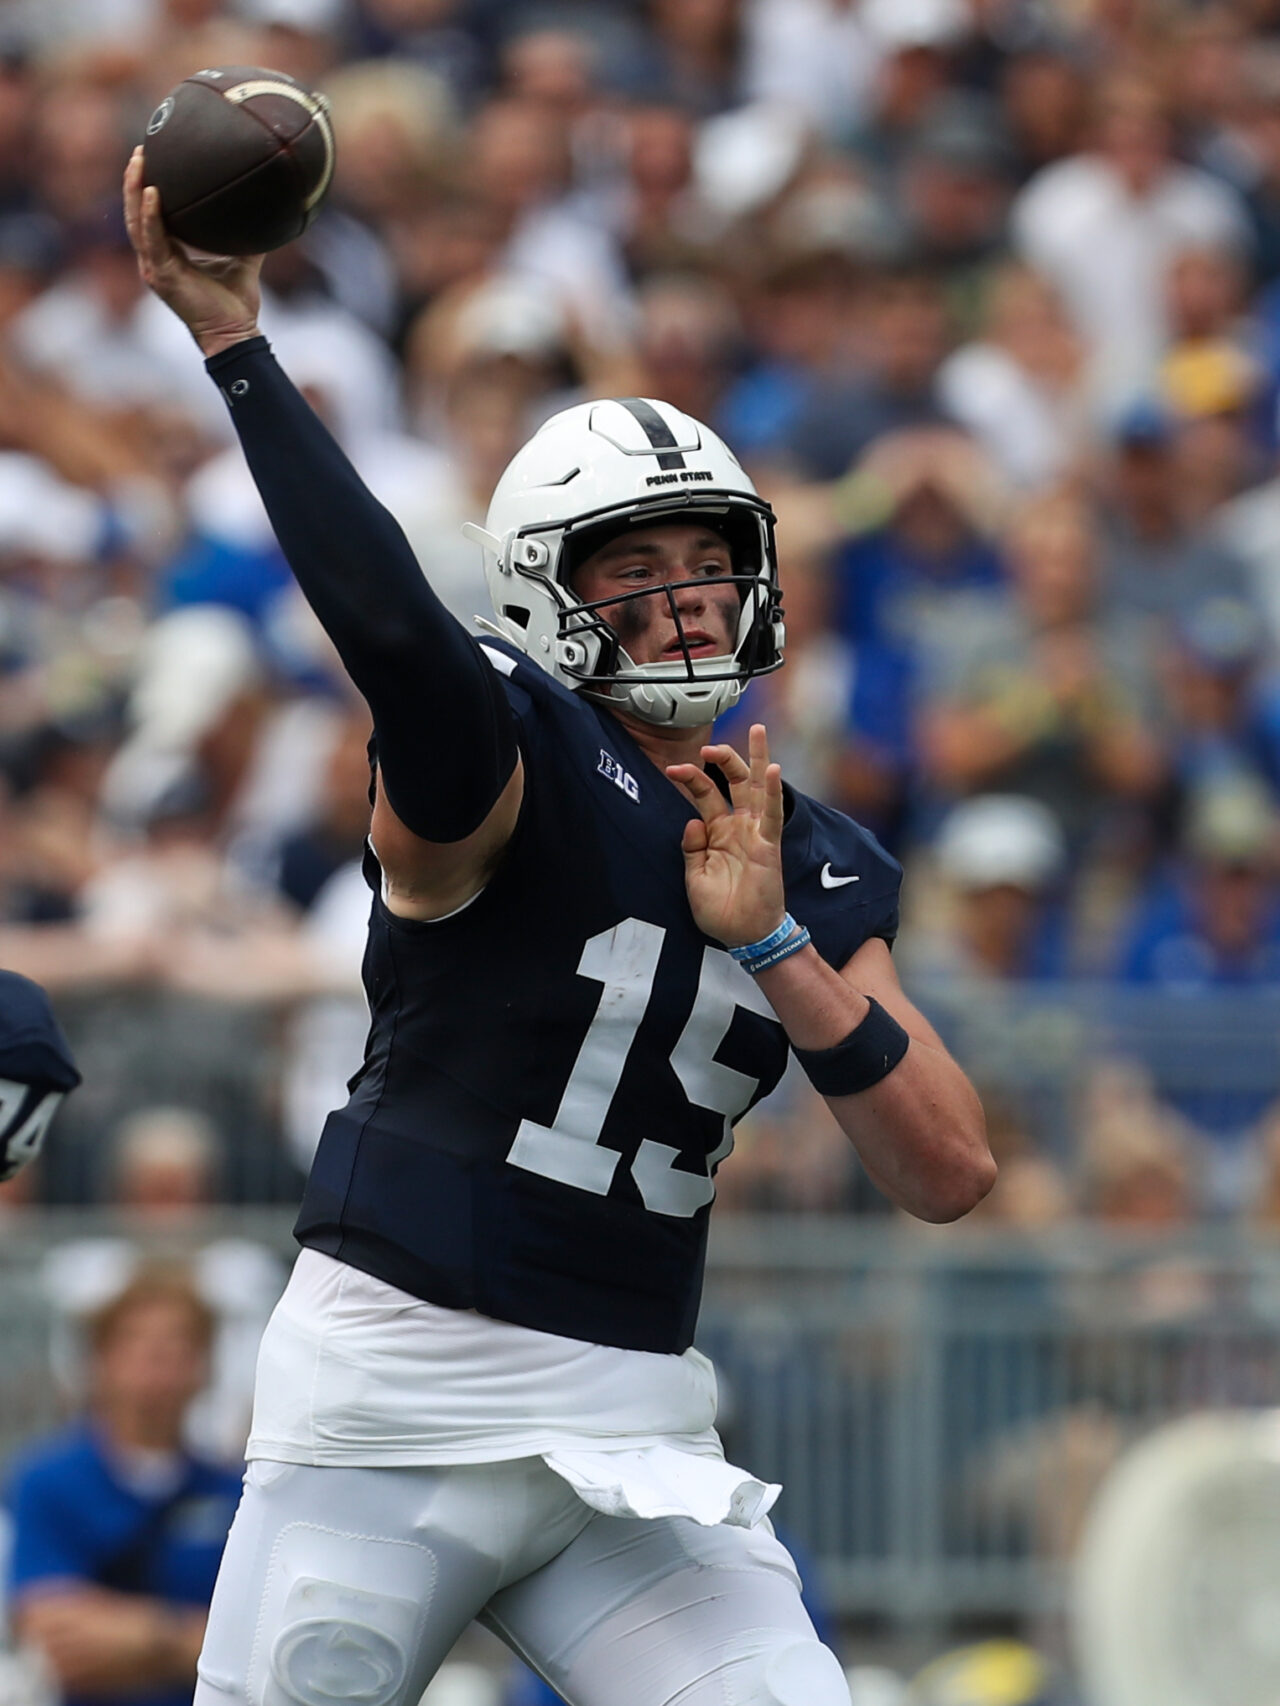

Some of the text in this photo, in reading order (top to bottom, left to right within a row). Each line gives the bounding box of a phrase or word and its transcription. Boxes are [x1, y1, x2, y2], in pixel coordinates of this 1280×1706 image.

[646, 471, 714, 487] PENN STATE
[505, 916, 783, 1219] 15
